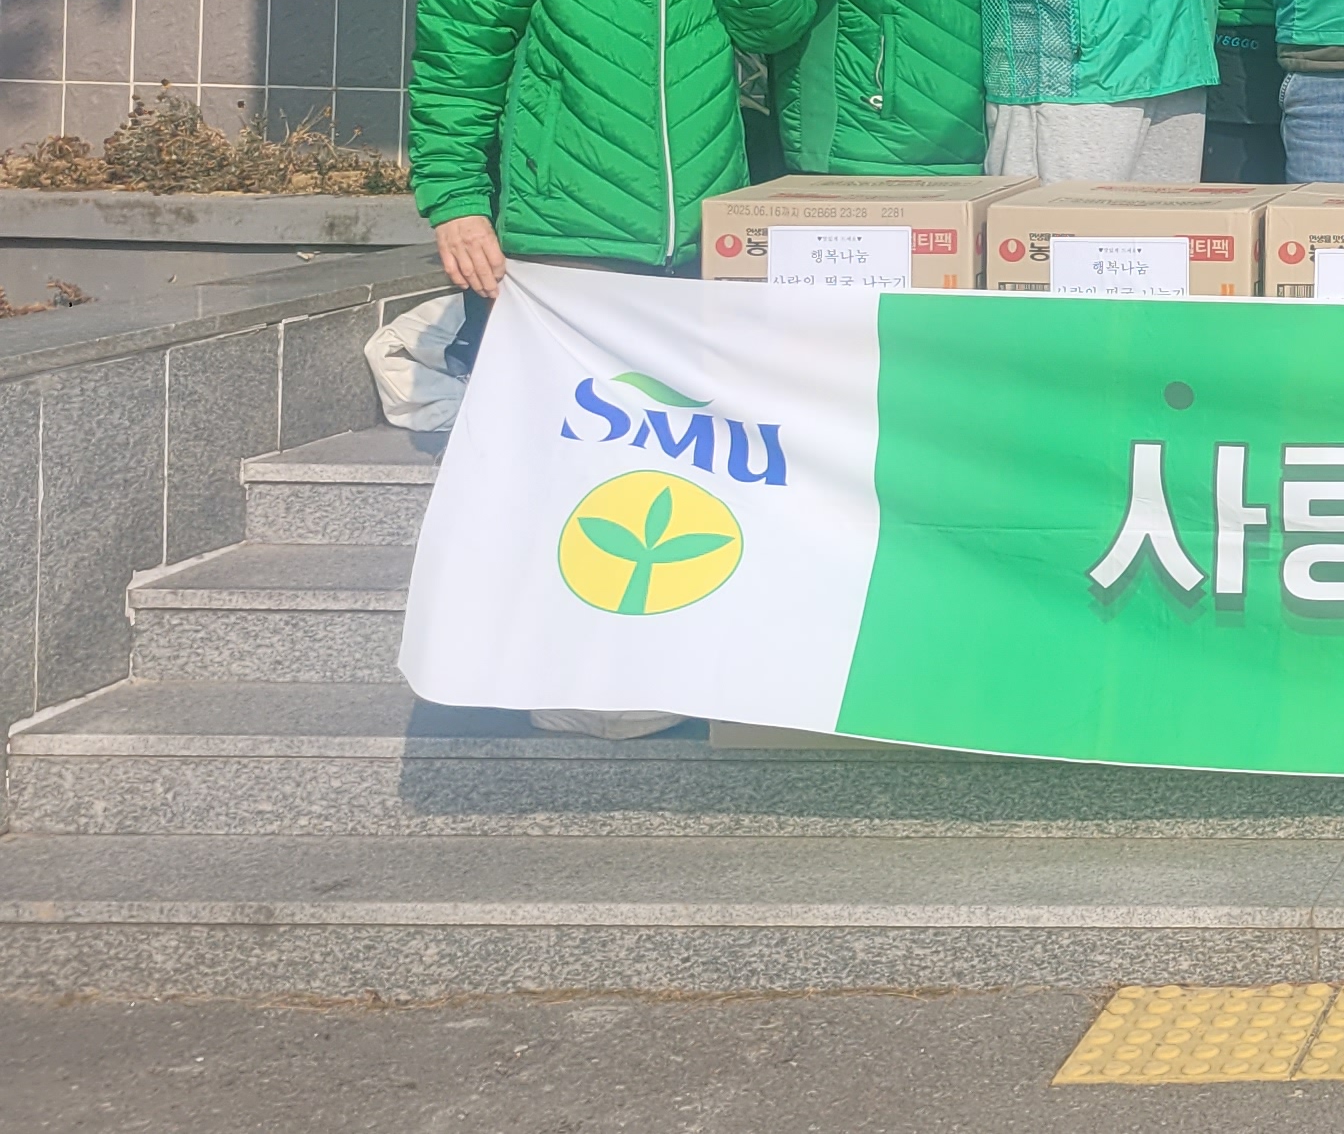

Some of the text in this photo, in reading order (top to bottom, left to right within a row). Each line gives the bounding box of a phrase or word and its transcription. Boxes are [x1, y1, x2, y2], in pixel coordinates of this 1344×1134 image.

[840, 207, 868, 218] 23:28
[881, 207, 905, 218] 2281
[811, 249, 870, 264] 행복나눔
[1092, 260, 1150, 276] 행복나눔
[561, 376, 788, 486] SMU
